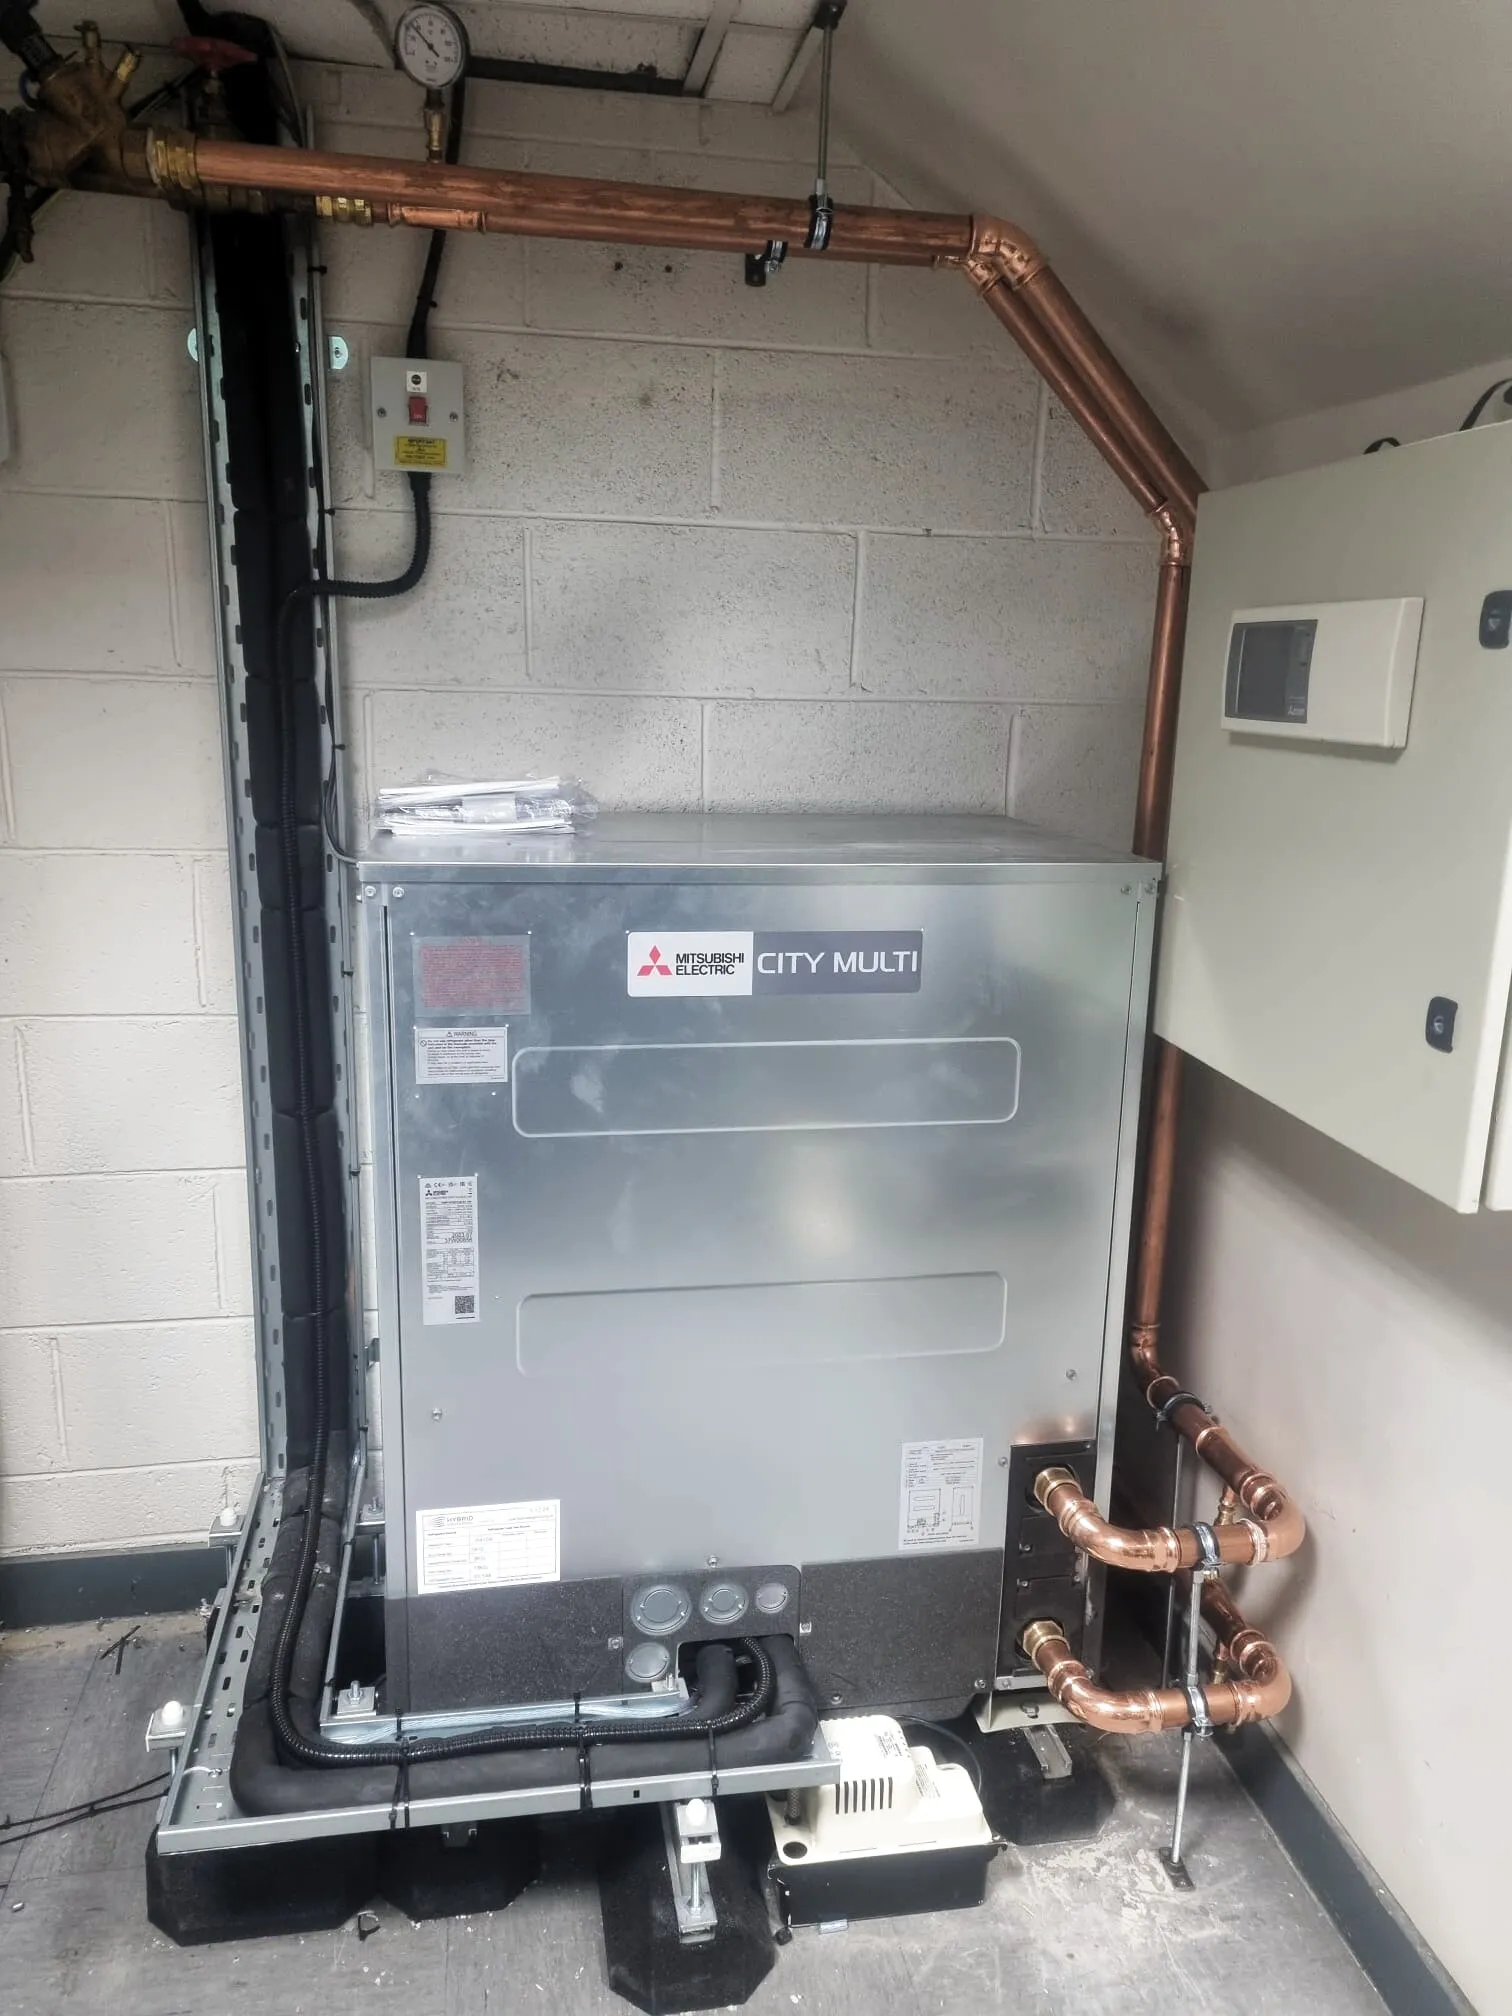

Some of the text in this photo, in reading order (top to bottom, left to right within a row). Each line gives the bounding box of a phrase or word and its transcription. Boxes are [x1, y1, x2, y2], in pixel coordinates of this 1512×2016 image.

[676, 952, 745, 965] MITSUBISHI
[757, 950, 919, 974] CITY MULTI
[676, 963, 735, 976] ELECTRIC
[446, 1515, 474, 1523] HYBRID
